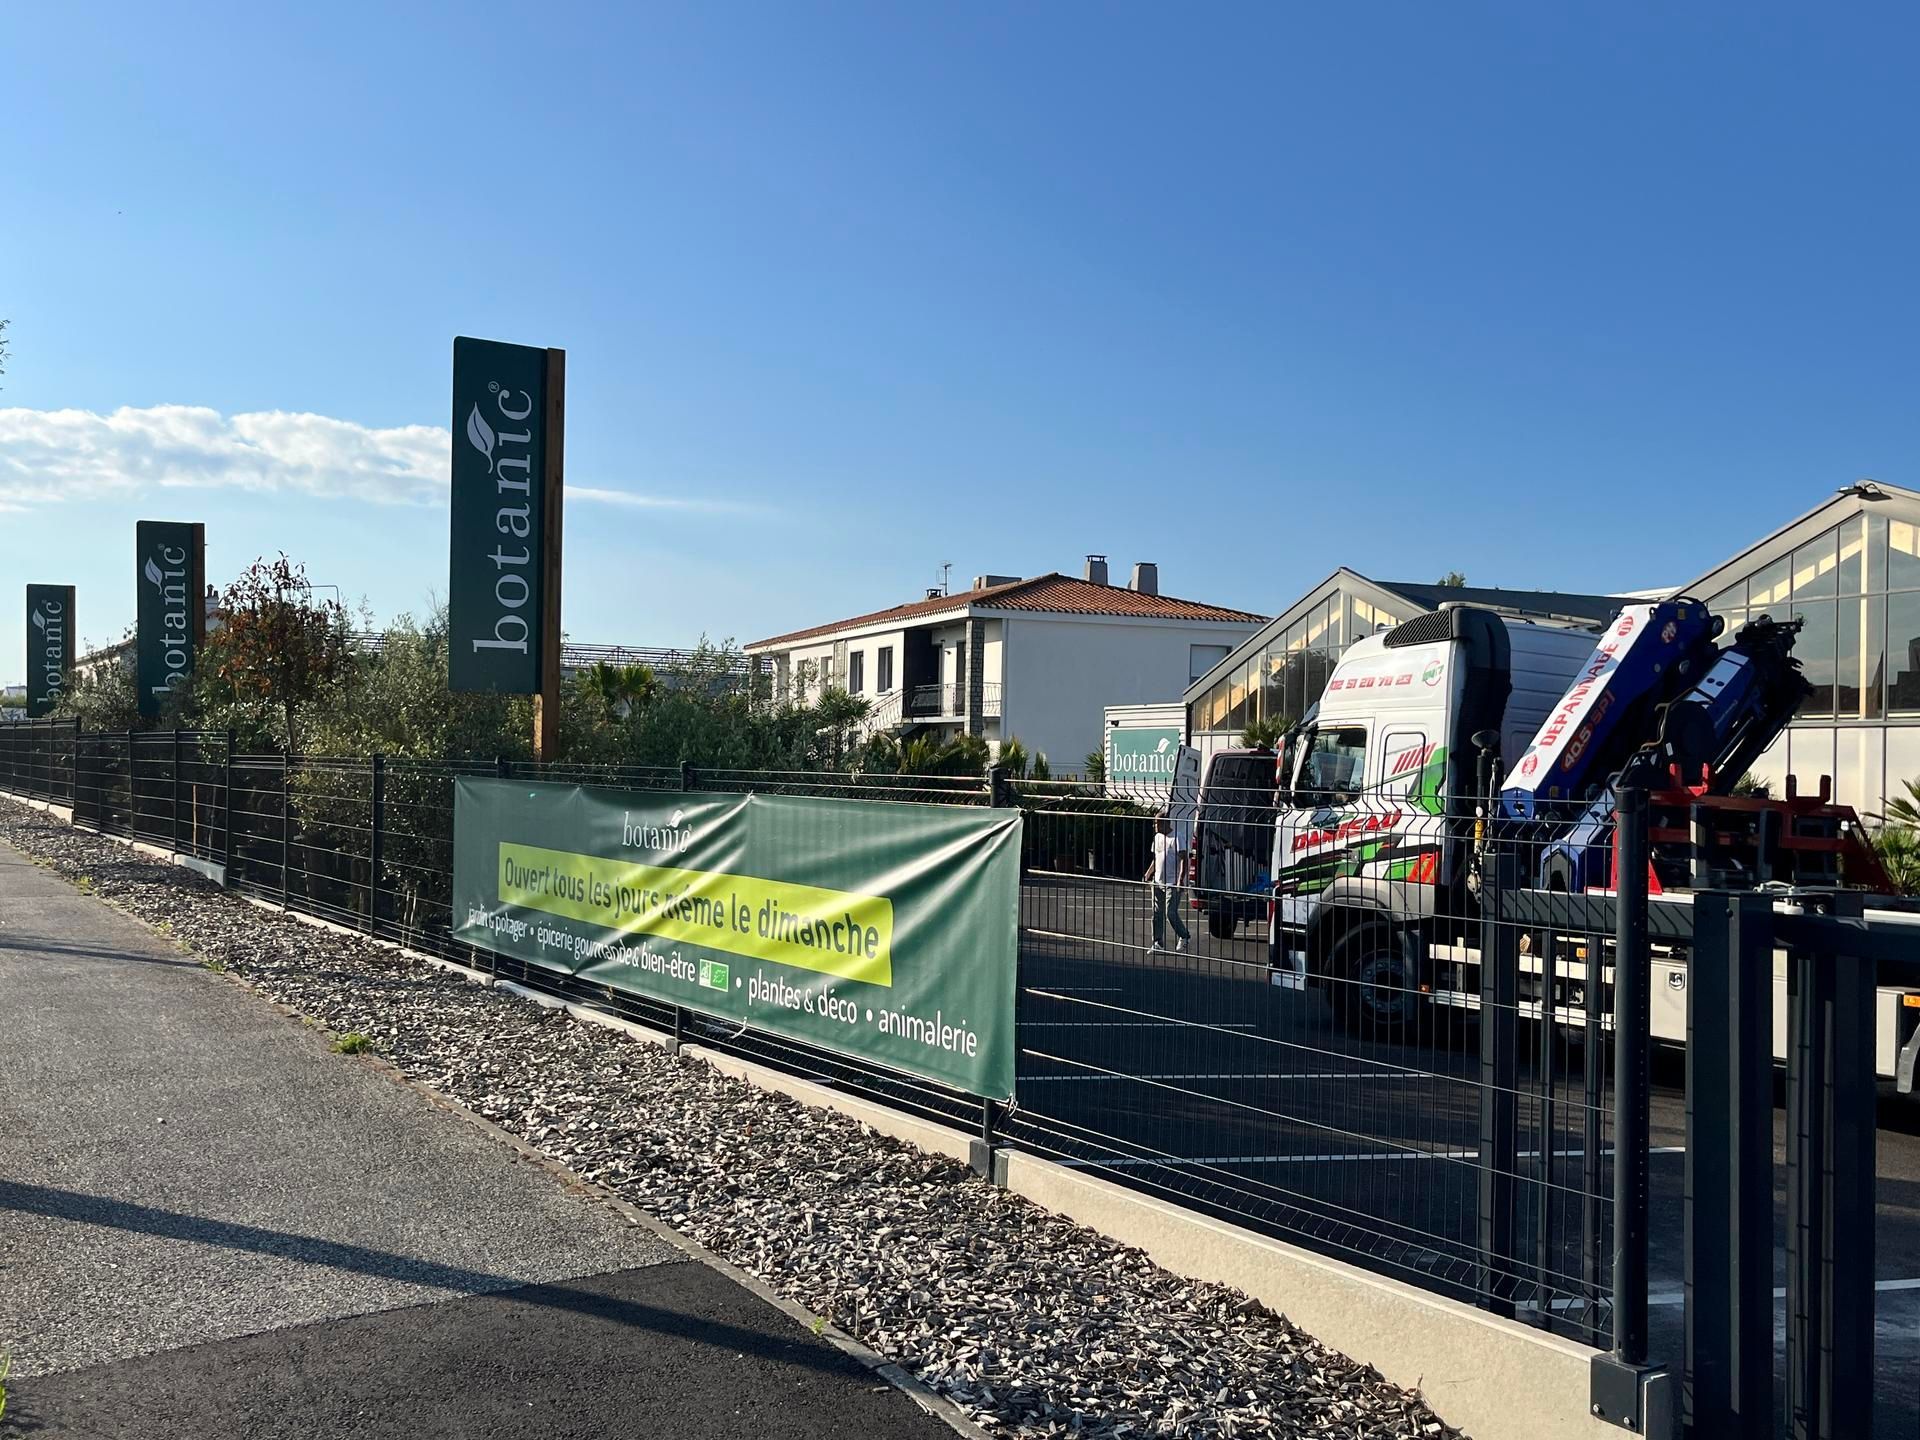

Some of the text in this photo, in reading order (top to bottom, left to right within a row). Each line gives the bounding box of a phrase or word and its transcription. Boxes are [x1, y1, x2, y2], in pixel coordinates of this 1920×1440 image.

[467, 389, 532, 655] botanic
[33, 600, 63, 703] botanic
[146, 545, 187, 695] botanic
[1539, 642, 1619, 746] DEPANNAGE
[1112, 739, 1175, 774] botanic
[622, 810, 690, 853] botanic
[505, 856, 550, 895] Ouvert
[553, 867, 584, 903] tous
[588, 872, 612, 909] les
[614, 877, 659, 919] jours
[732, 893, 751, 934] le
[758, 898, 879, 959] dimanche
[466, 901, 489, 928] jardin
[495, 912, 528, 942] potager
[537, 920, 573, 951] épicerie
[632, 946, 639, 968] &
[641, 941, 696, 983] bien-être
[748, 968, 801, 1010] plantes
[803, 988, 815, 1014] &
[817, 984, 858, 1024] déco
[878, 1004, 978, 1058] animalerie
